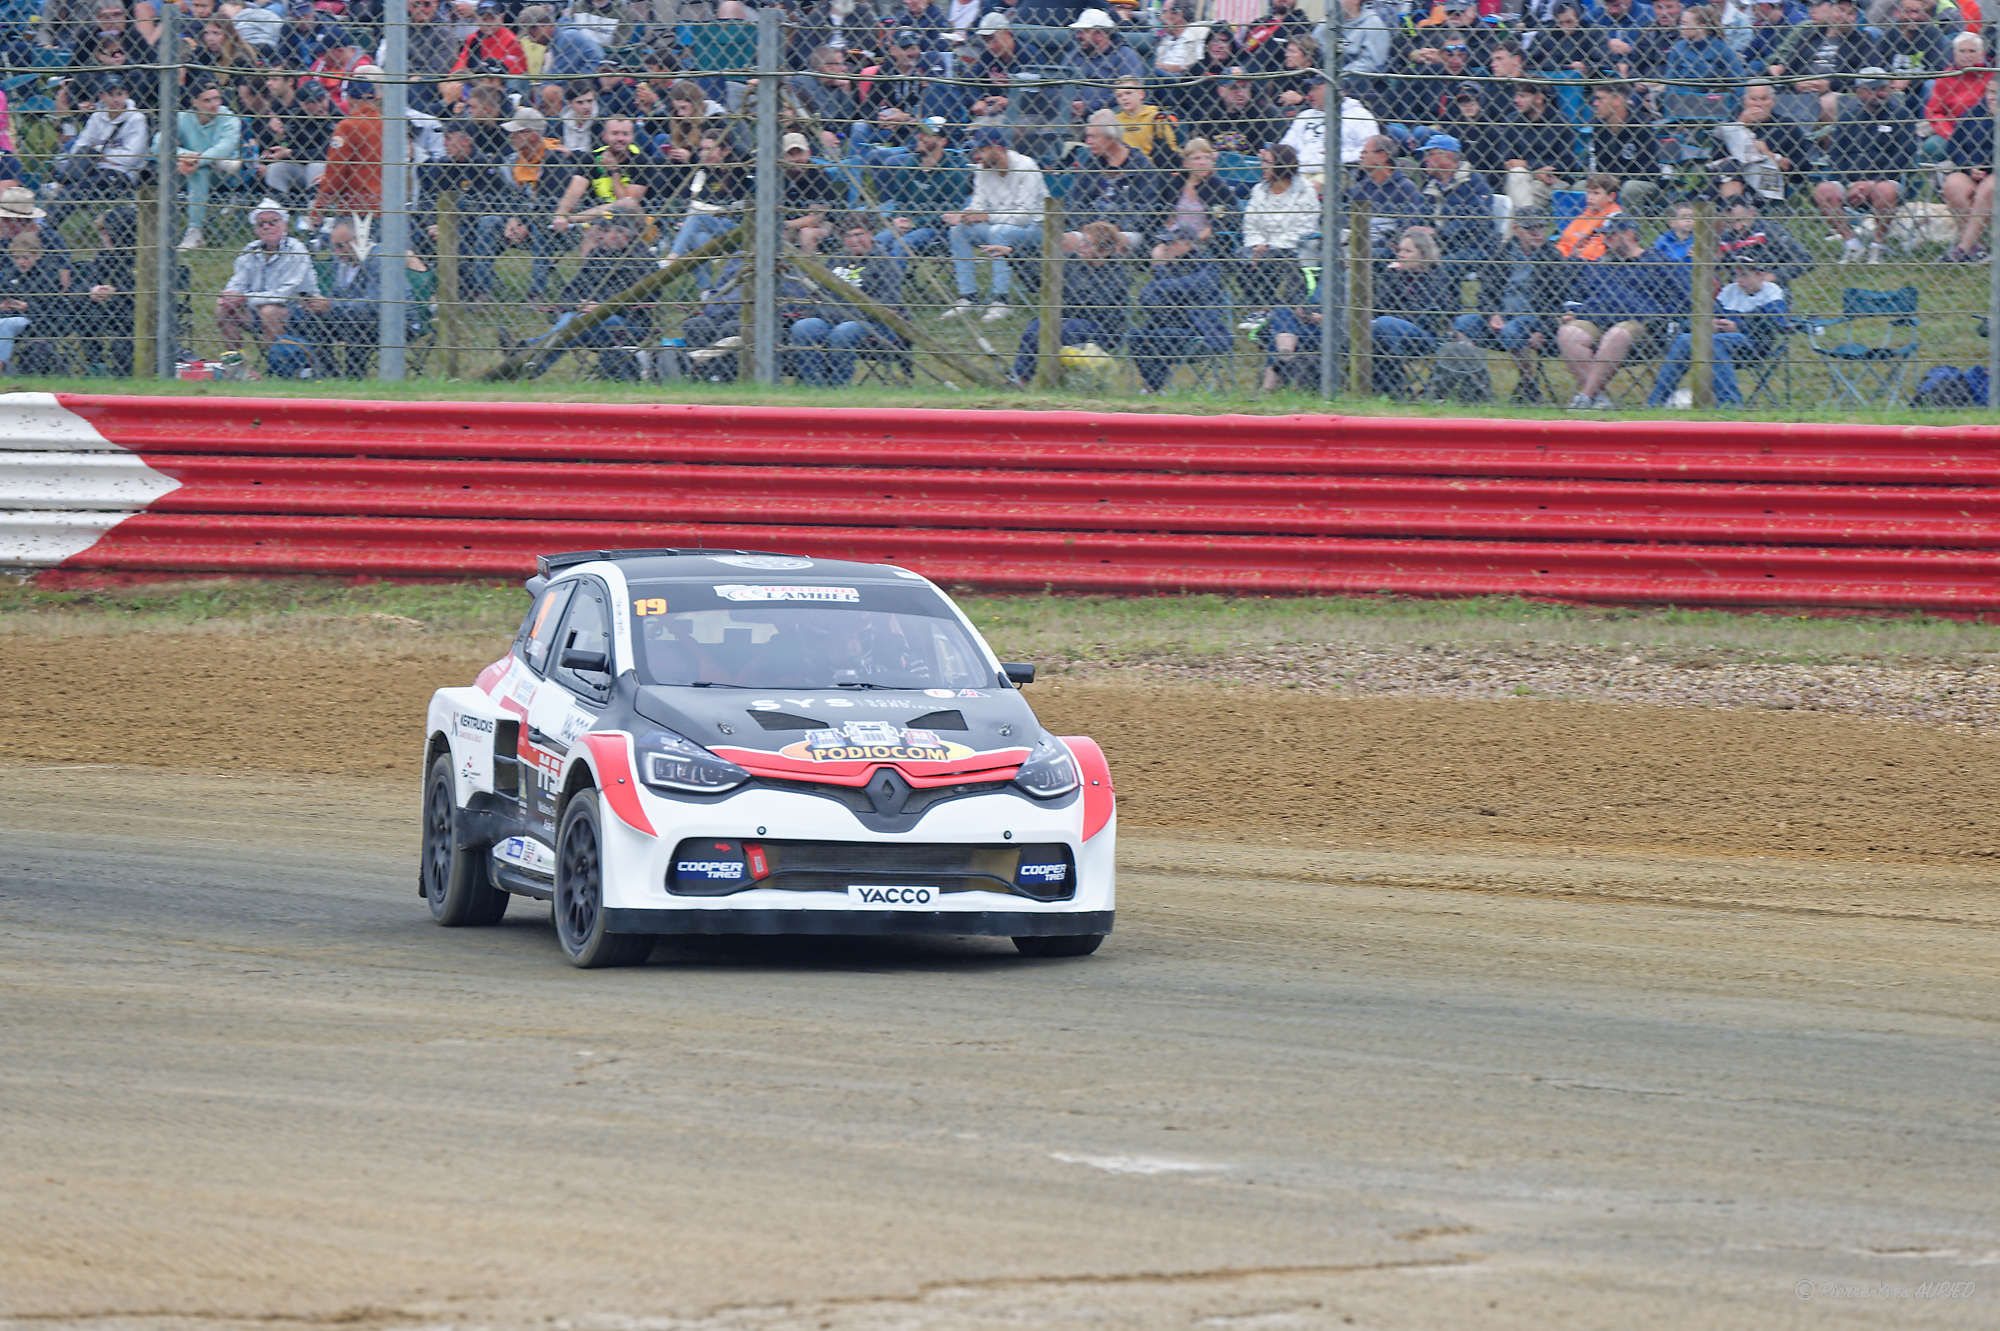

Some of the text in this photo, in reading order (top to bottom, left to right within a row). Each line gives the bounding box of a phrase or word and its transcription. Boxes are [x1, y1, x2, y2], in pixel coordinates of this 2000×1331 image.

[633, 598, 667, 616] 19
[752, 698, 855, 710] SYS
[812, 746, 947, 760] PODIOCOM
[677, 862, 744, 872] COOPER
[1021, 864, 1067, 875] COOPER
[706, 871, 742, 879] TIRES
[1045, 873, 1065, 881] TIRES
[858, 888, 930, 904] YACCO
